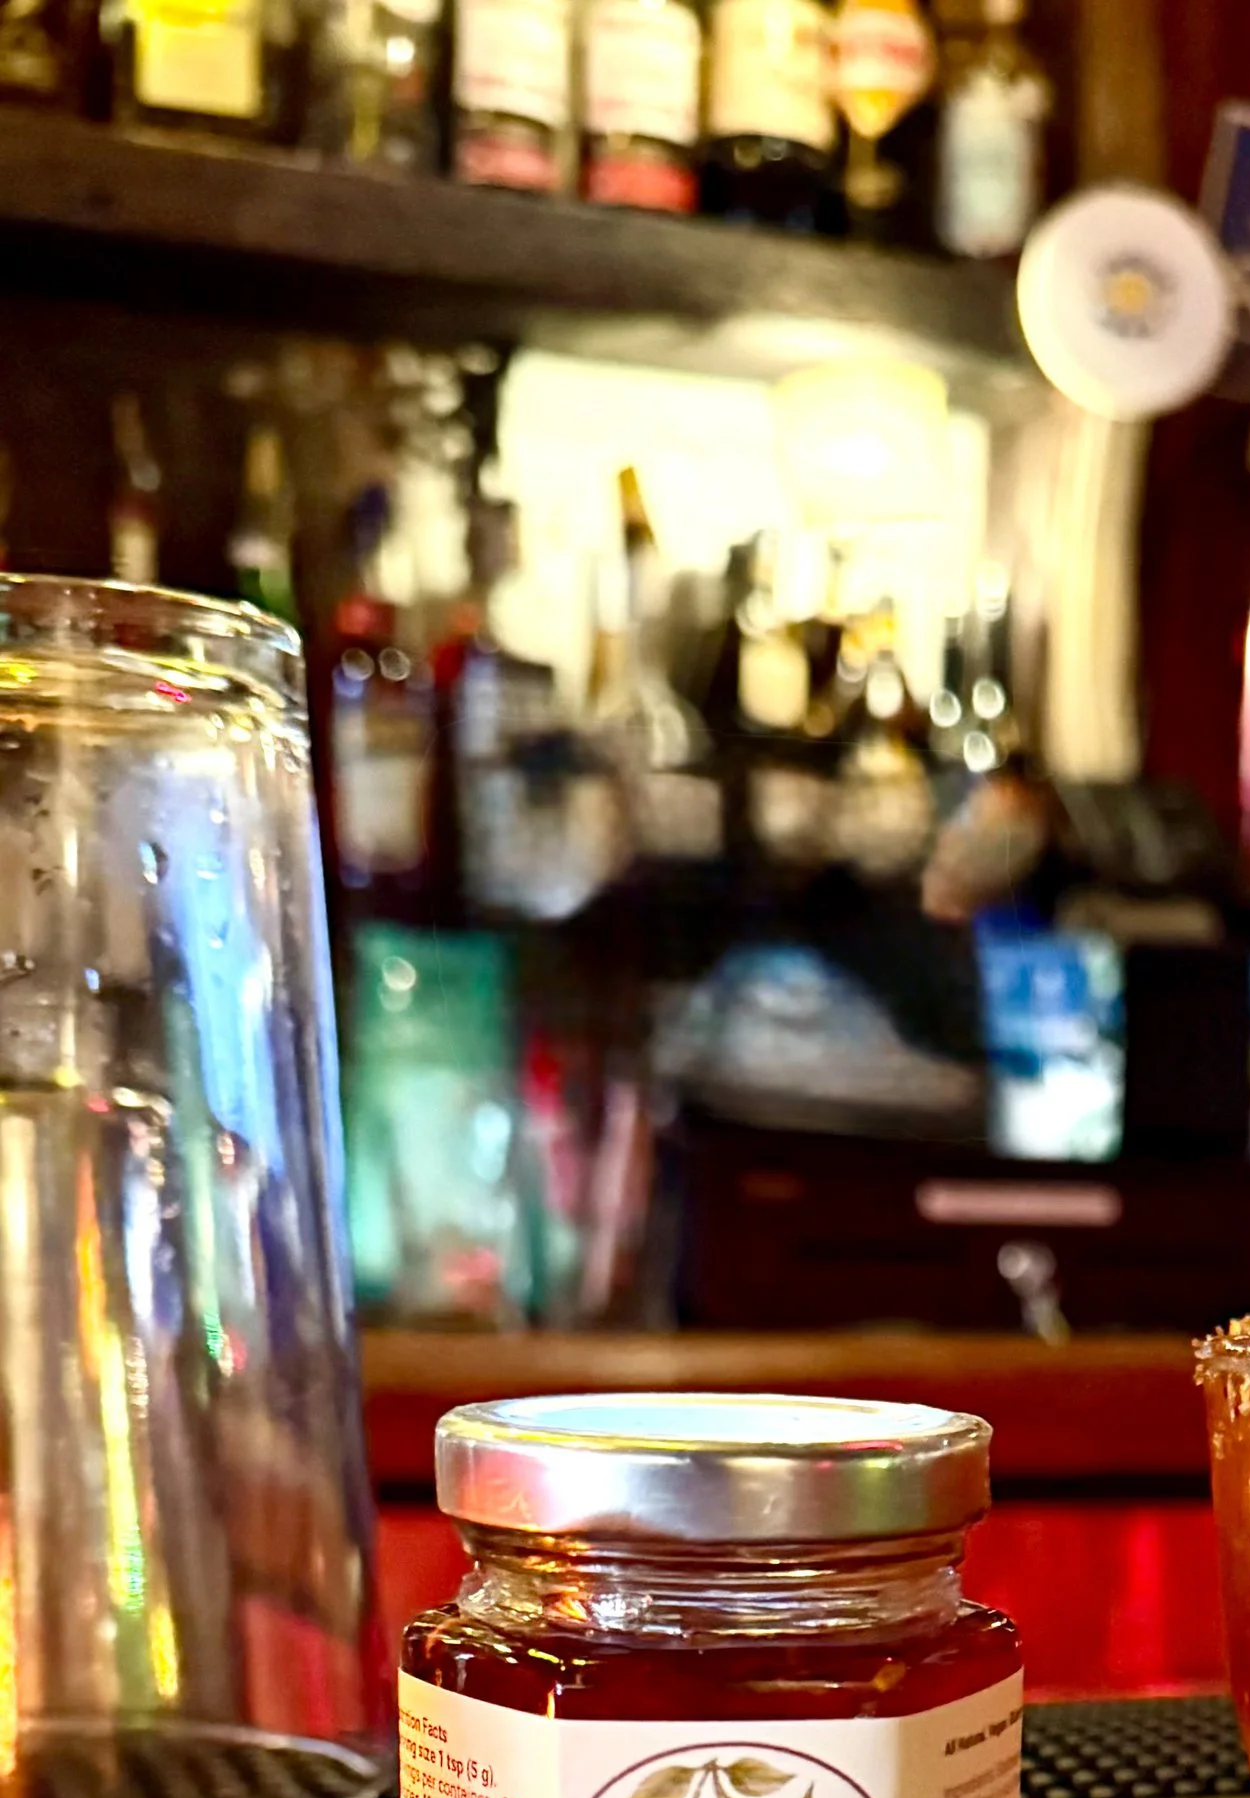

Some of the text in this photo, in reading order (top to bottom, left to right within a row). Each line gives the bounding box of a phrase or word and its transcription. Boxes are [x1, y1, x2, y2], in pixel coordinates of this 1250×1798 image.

[422, 1716, 448, 1743] Facts
[418, 1745, 436, 1764] size
[438, 1750, 443, 1767] 1
[447, 1754, 464, 1779] tsp
[467, 1758, 478, 1783] (5
[422, 1772, 436, 1789] per
